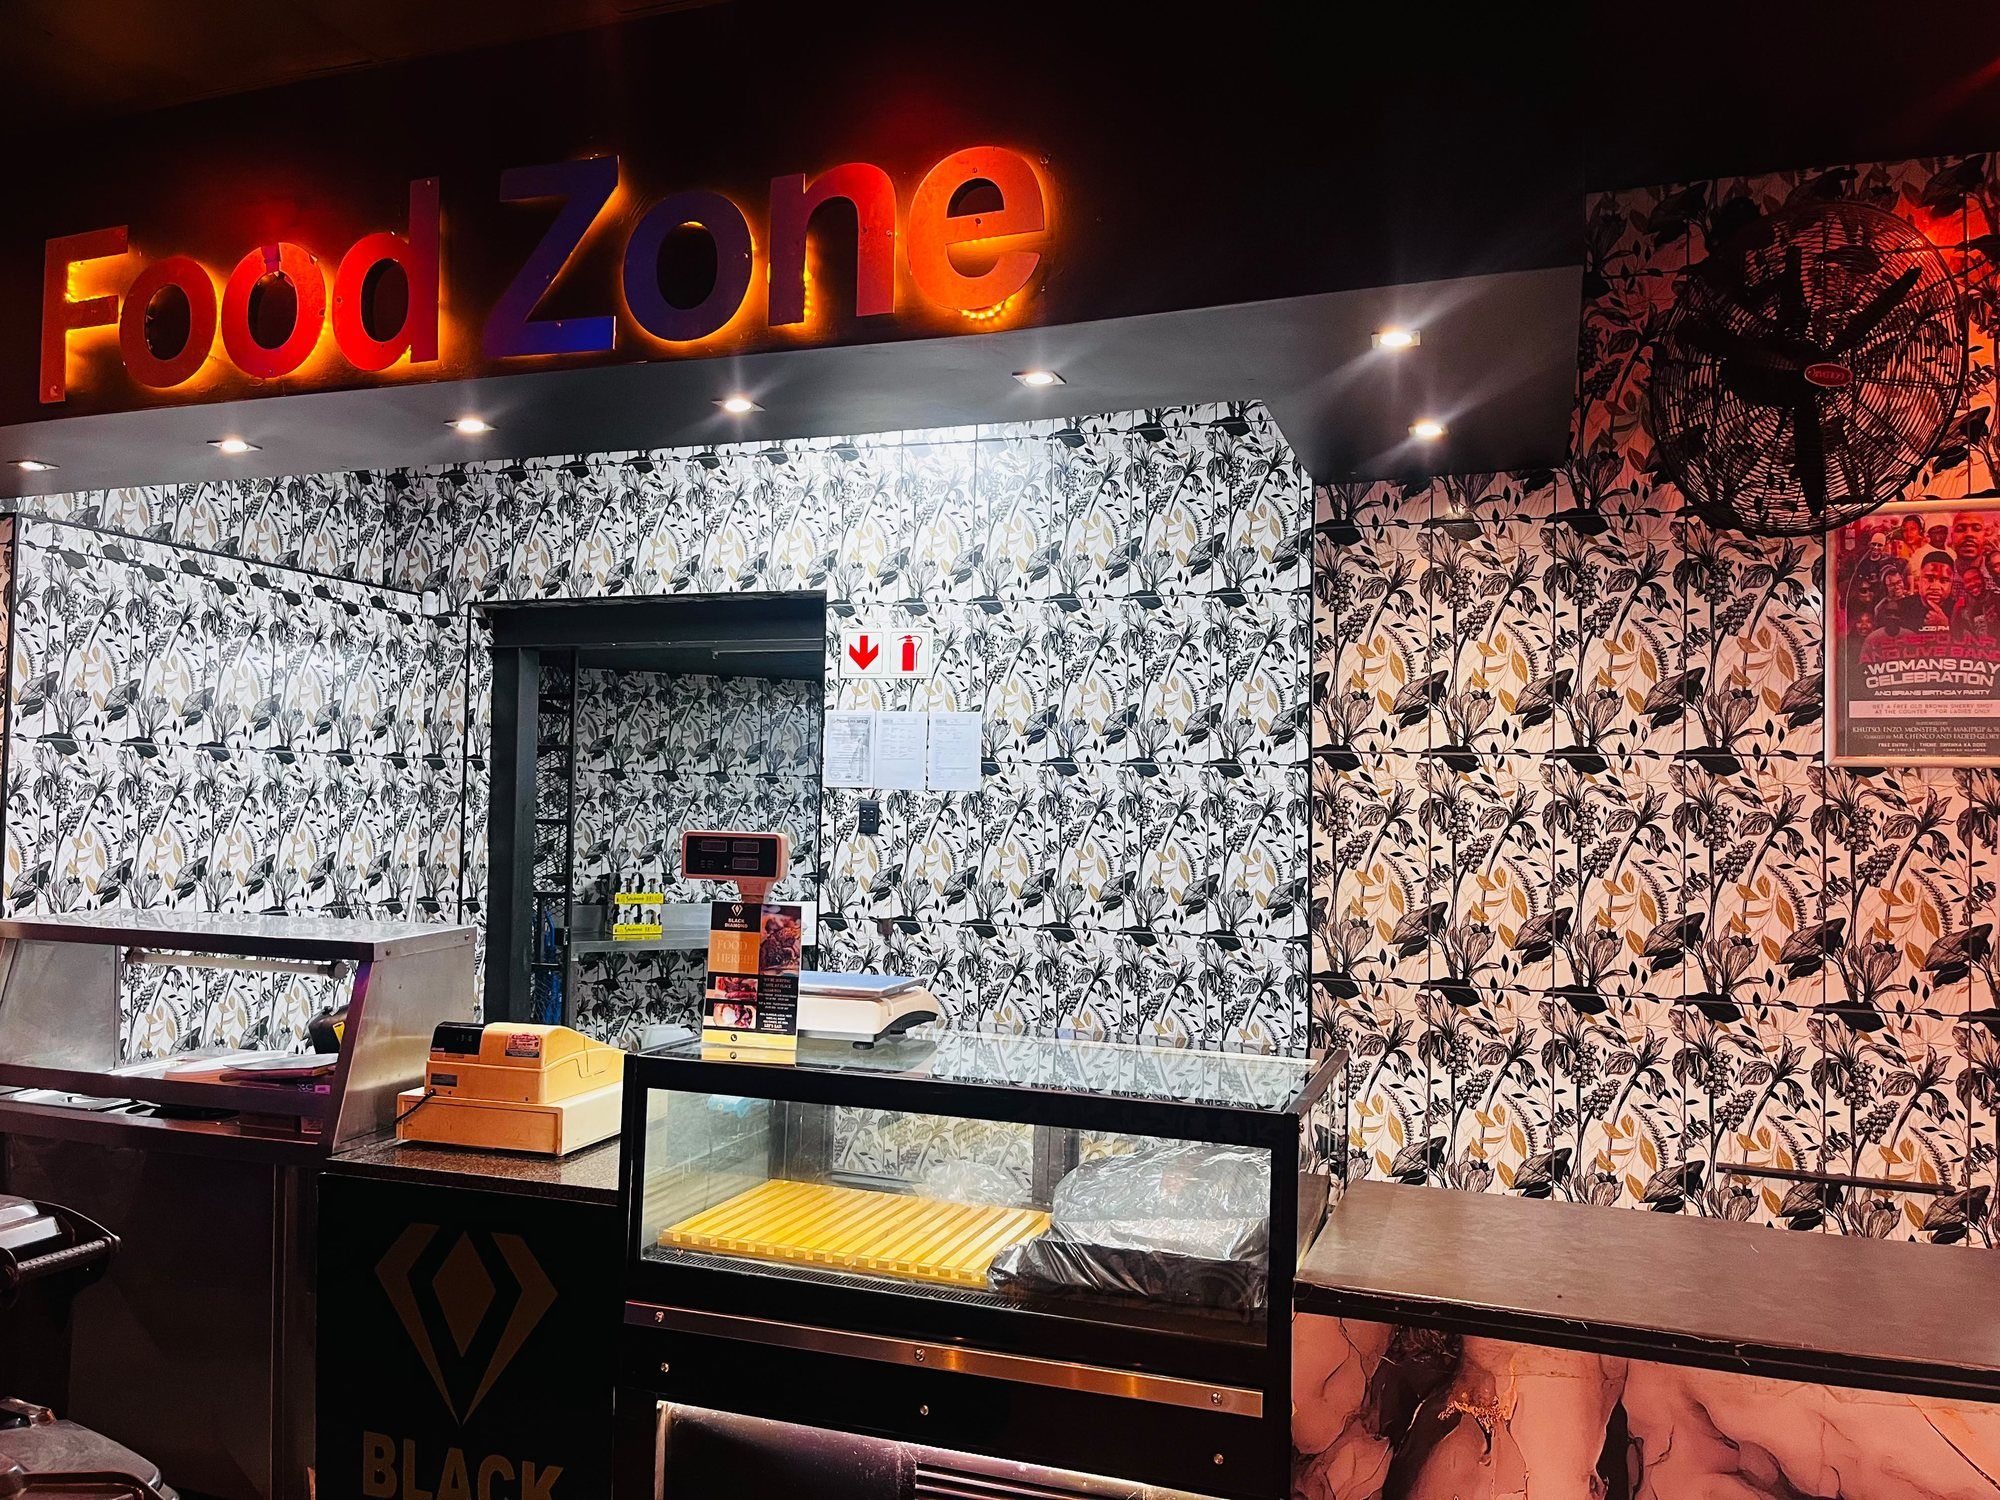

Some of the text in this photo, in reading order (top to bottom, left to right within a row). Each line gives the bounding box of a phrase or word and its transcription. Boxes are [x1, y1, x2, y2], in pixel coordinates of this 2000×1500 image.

[39, 146, 1049, 404] Food Zone
[1860, 648, 1900, 663] AND
[1903, 646, 1945, 659] LIVE
[1868, 659, 2000, 675] WOMANS DAY
[1865, 672, 1994, 689] CELEBRATION
[717, 939, 748, 951] FOOD
[363, 1430, 564, 1500] BLACK
